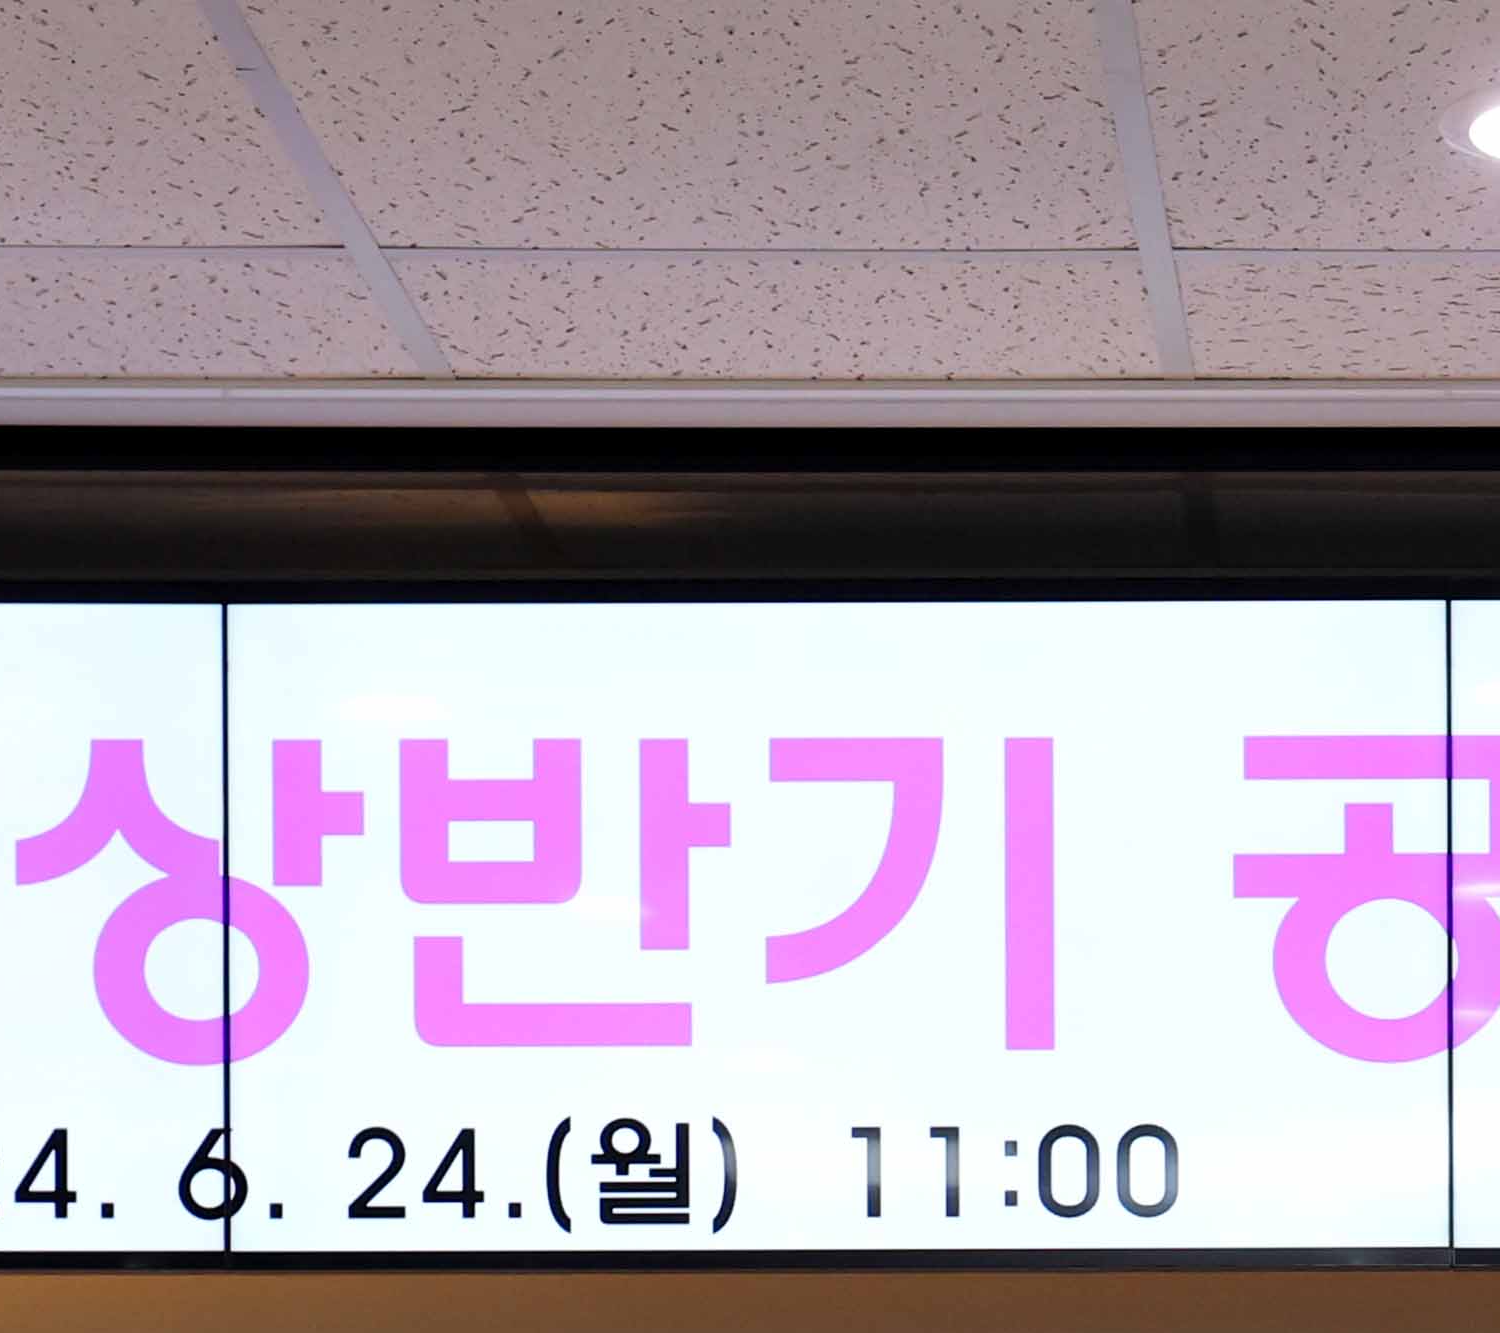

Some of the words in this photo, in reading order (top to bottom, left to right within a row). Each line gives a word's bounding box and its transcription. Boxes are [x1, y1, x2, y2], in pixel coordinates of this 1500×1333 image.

[16, 738, 1055, 1065] 상반기
[178, 1127, 283, 1221] 6.
[347, 1116, 738, 1234] 24.(월)
[851, 1123, 1180, 1218] 11:00
